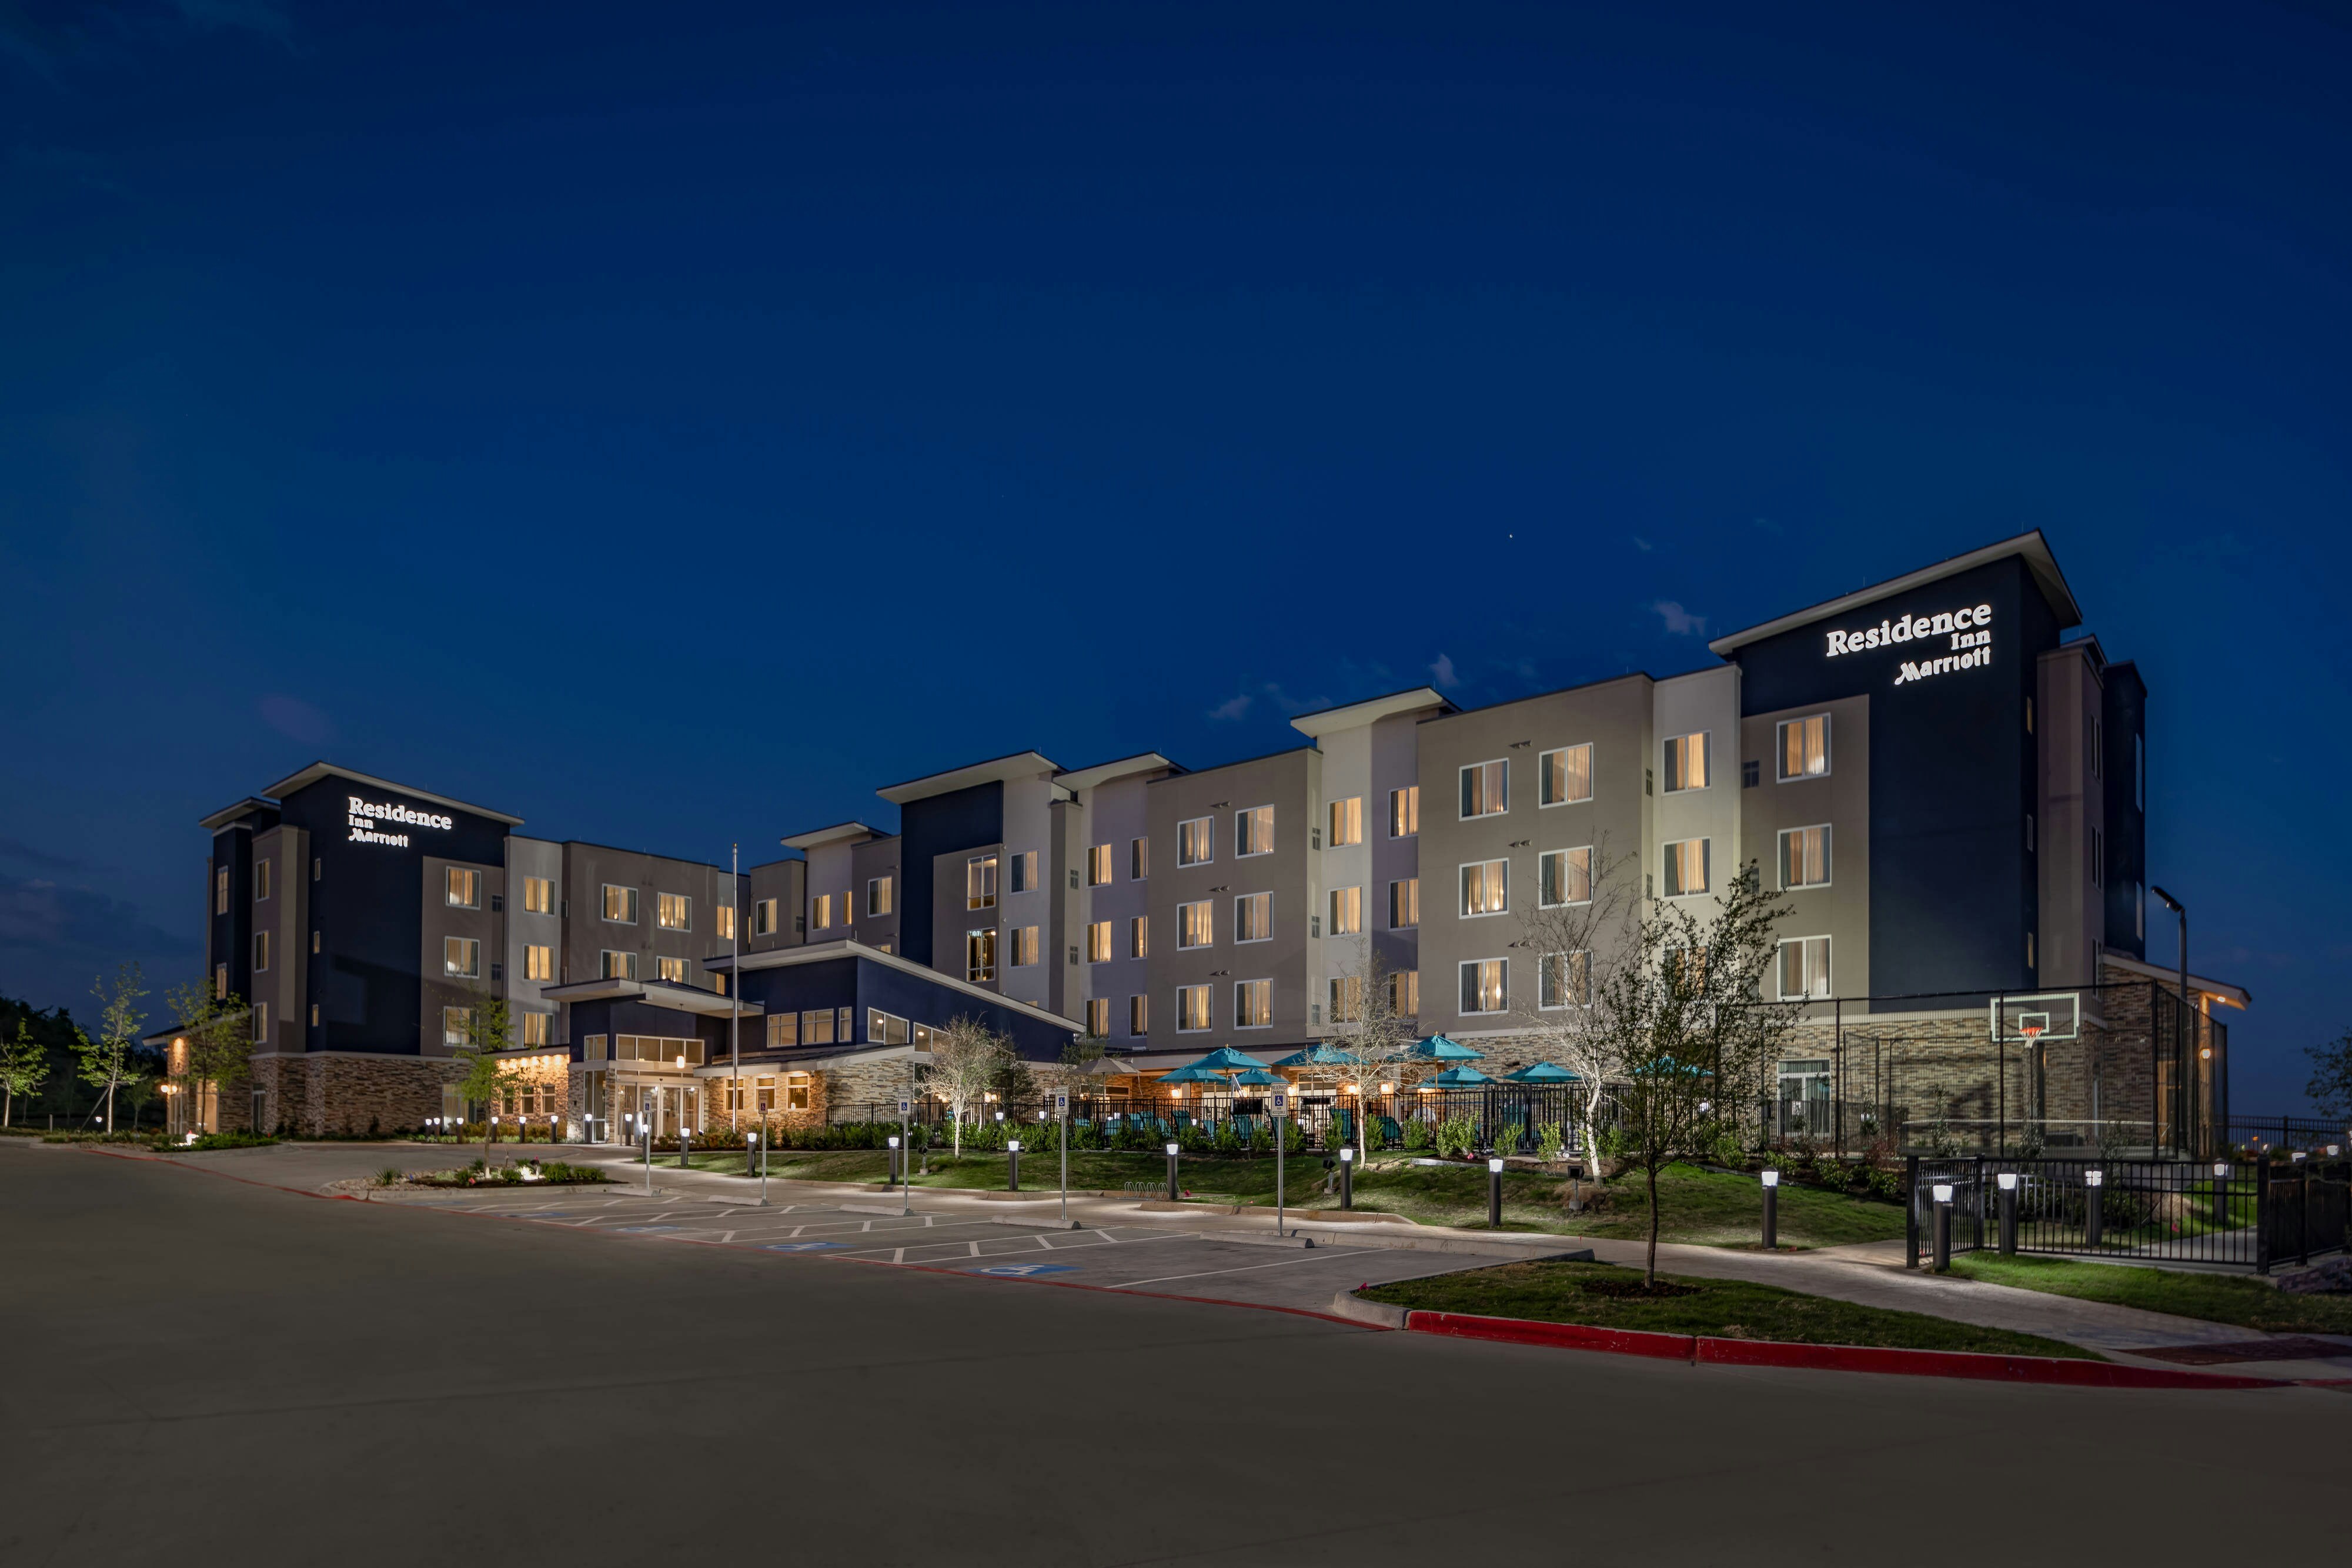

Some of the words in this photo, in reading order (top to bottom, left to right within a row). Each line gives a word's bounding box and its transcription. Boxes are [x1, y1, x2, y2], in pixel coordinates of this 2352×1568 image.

[1826, 603, 1992, 657] Residence
[1950, 629, 1992, 650] Inn
[1894, 646, 1991, 686] Marriott
[348, 796, 452, 830] Residence
[348, 814, 374, 830] Inn
[348, 827, 409, 848] Marriott
